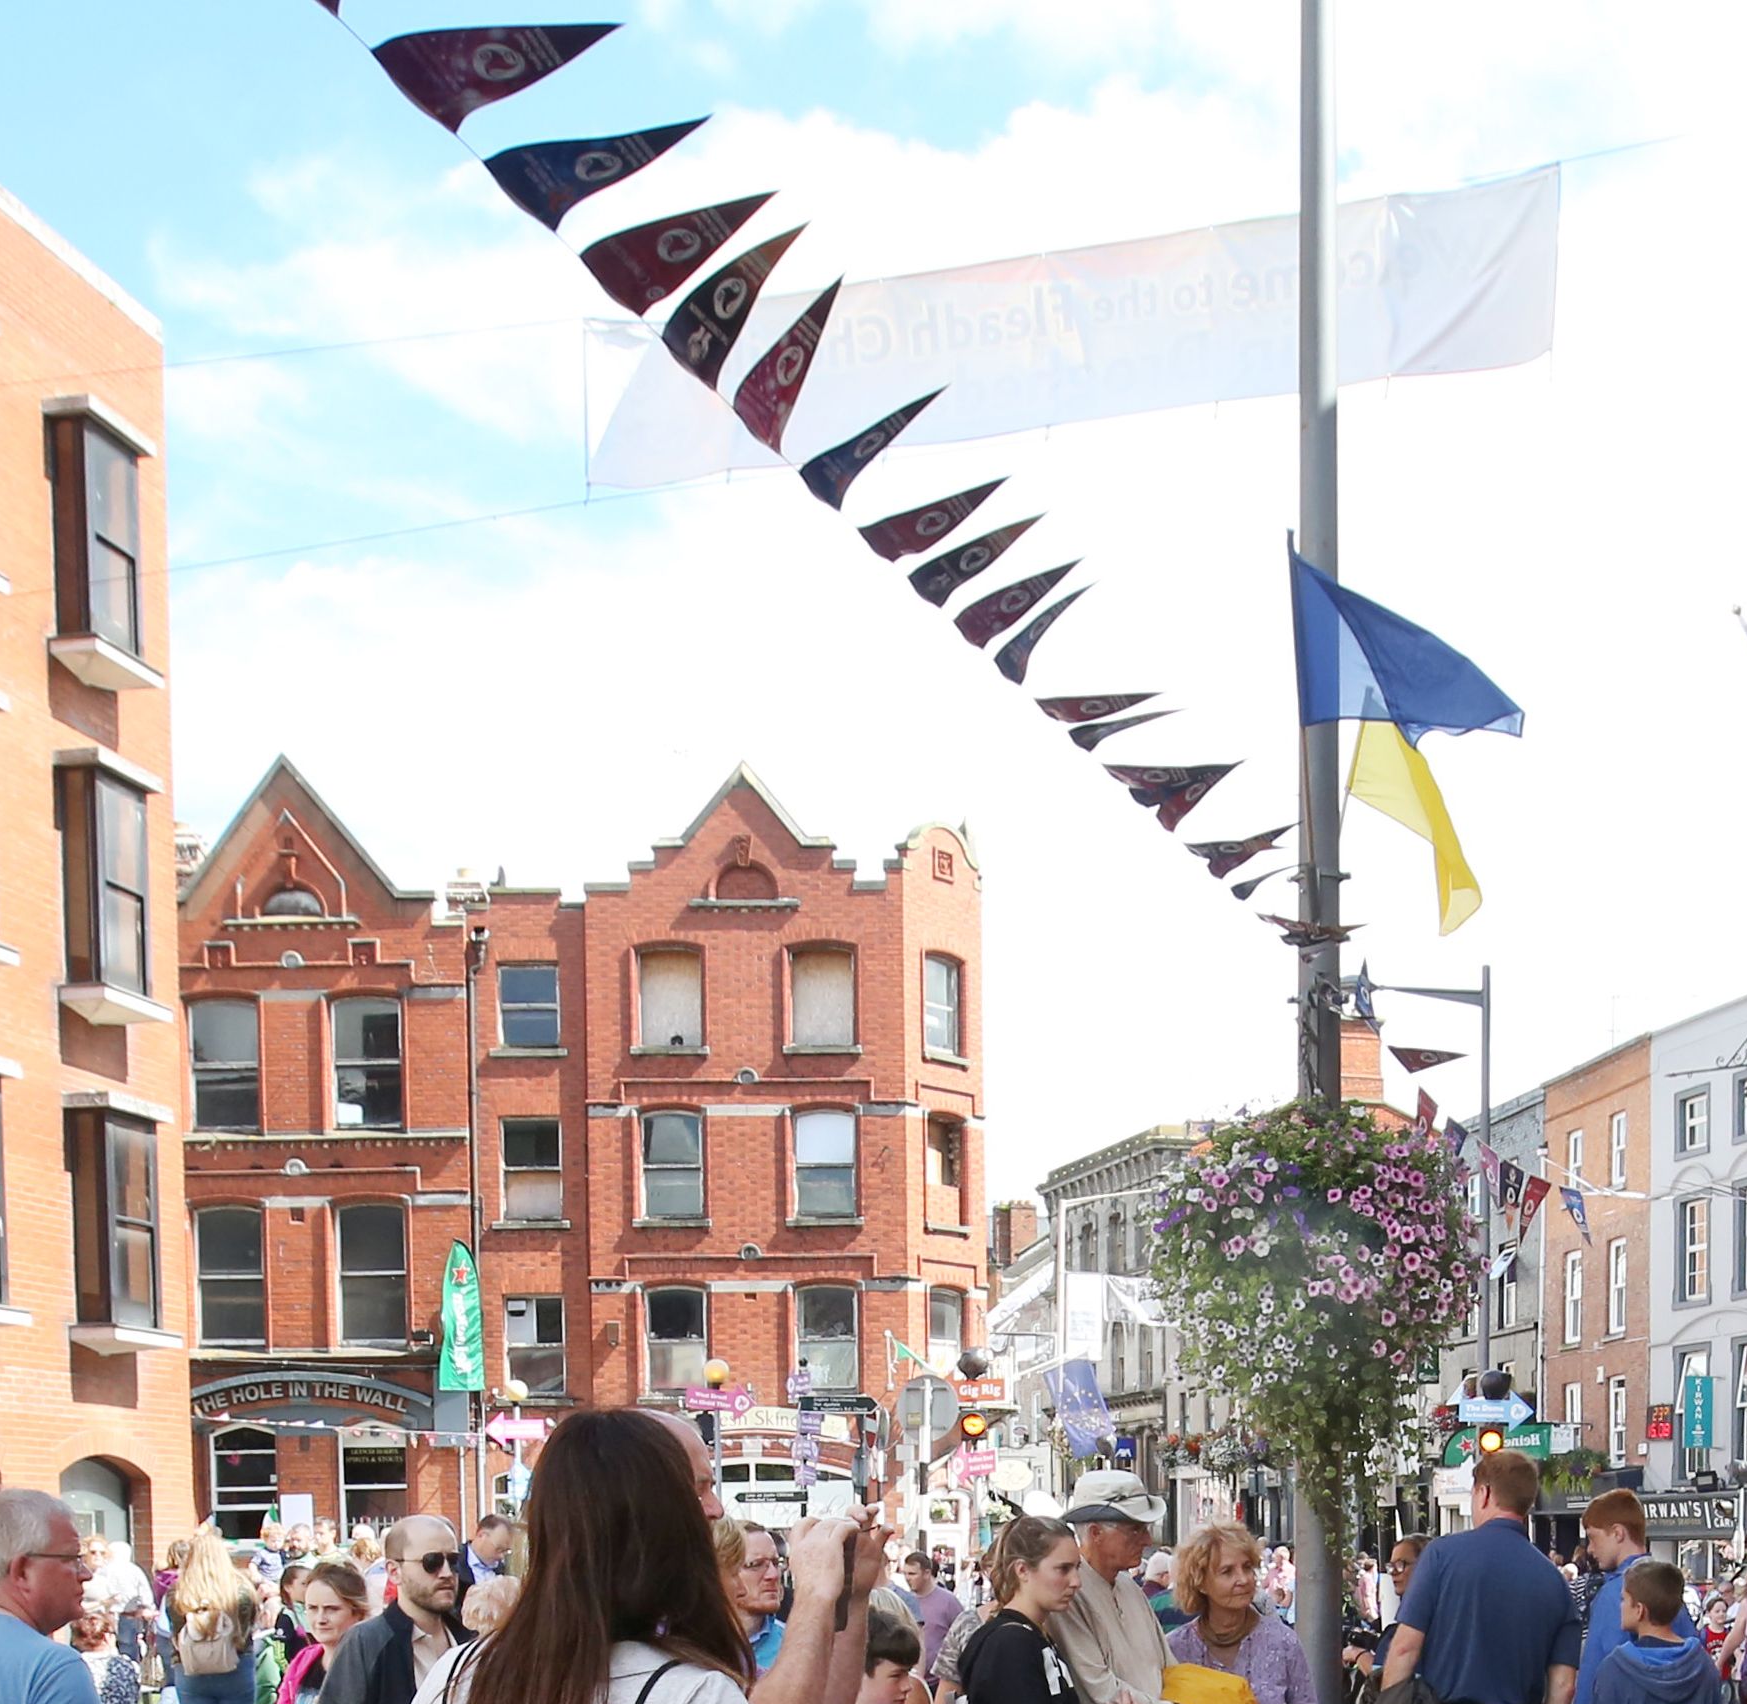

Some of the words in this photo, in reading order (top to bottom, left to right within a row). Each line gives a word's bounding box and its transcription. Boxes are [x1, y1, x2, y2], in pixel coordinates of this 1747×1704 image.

[191, 1391, 230, 1414] THE
[231, 1384, 283, 1403] HOLE
[288, 1382, 308, 1397] IN
[314, 1383, 350, 1400] THE
[354, 1387, 410, 1413] WALL
[958, 1384, 980, 1398] Gig
[981, 1383, 1003, 1398] Rig
[1644, 1500, 1702, 1518] IRWAN'S
